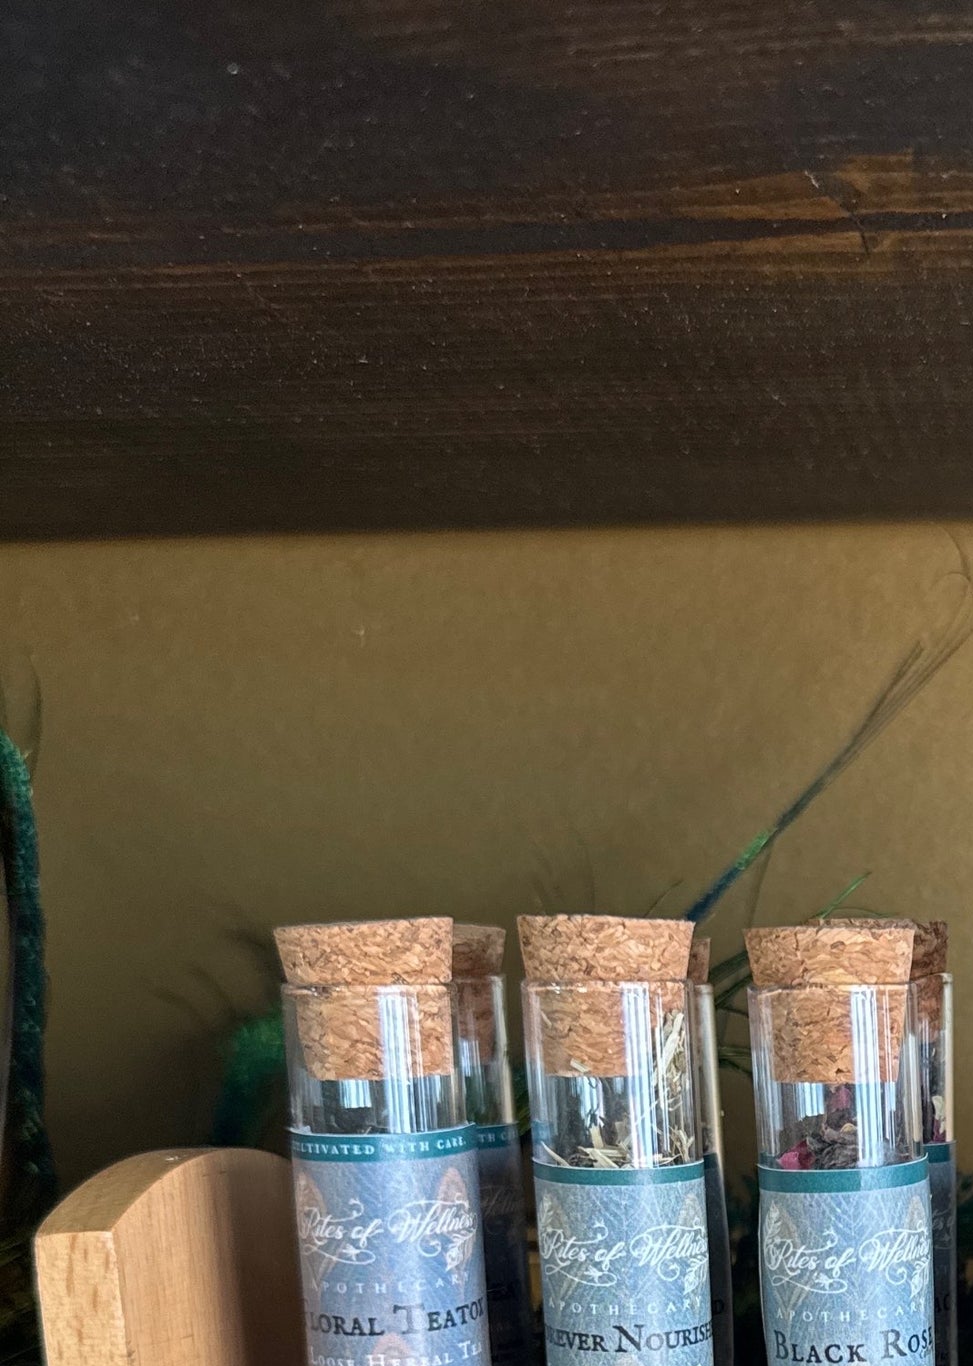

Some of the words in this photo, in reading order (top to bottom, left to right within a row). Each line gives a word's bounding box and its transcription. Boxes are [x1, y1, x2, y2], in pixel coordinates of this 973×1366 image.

[381, 1140, 430, 1154] WITH
[350, 1218, 384, 1247] of
[542, 1228, 590, 1266] Rites
[594, 1241, 627, 1271] of
[766, 1238, 820, 1275] Rites
[824, 1247, 857, 1278] of
[548, 1297, 701, 1316] APOTHECARY
[776, 1299, 925, 1323] APOTHECARY
[306, 1311, 386, 1337] LORAL
[773, 1329, 868, 1364] BLACK
